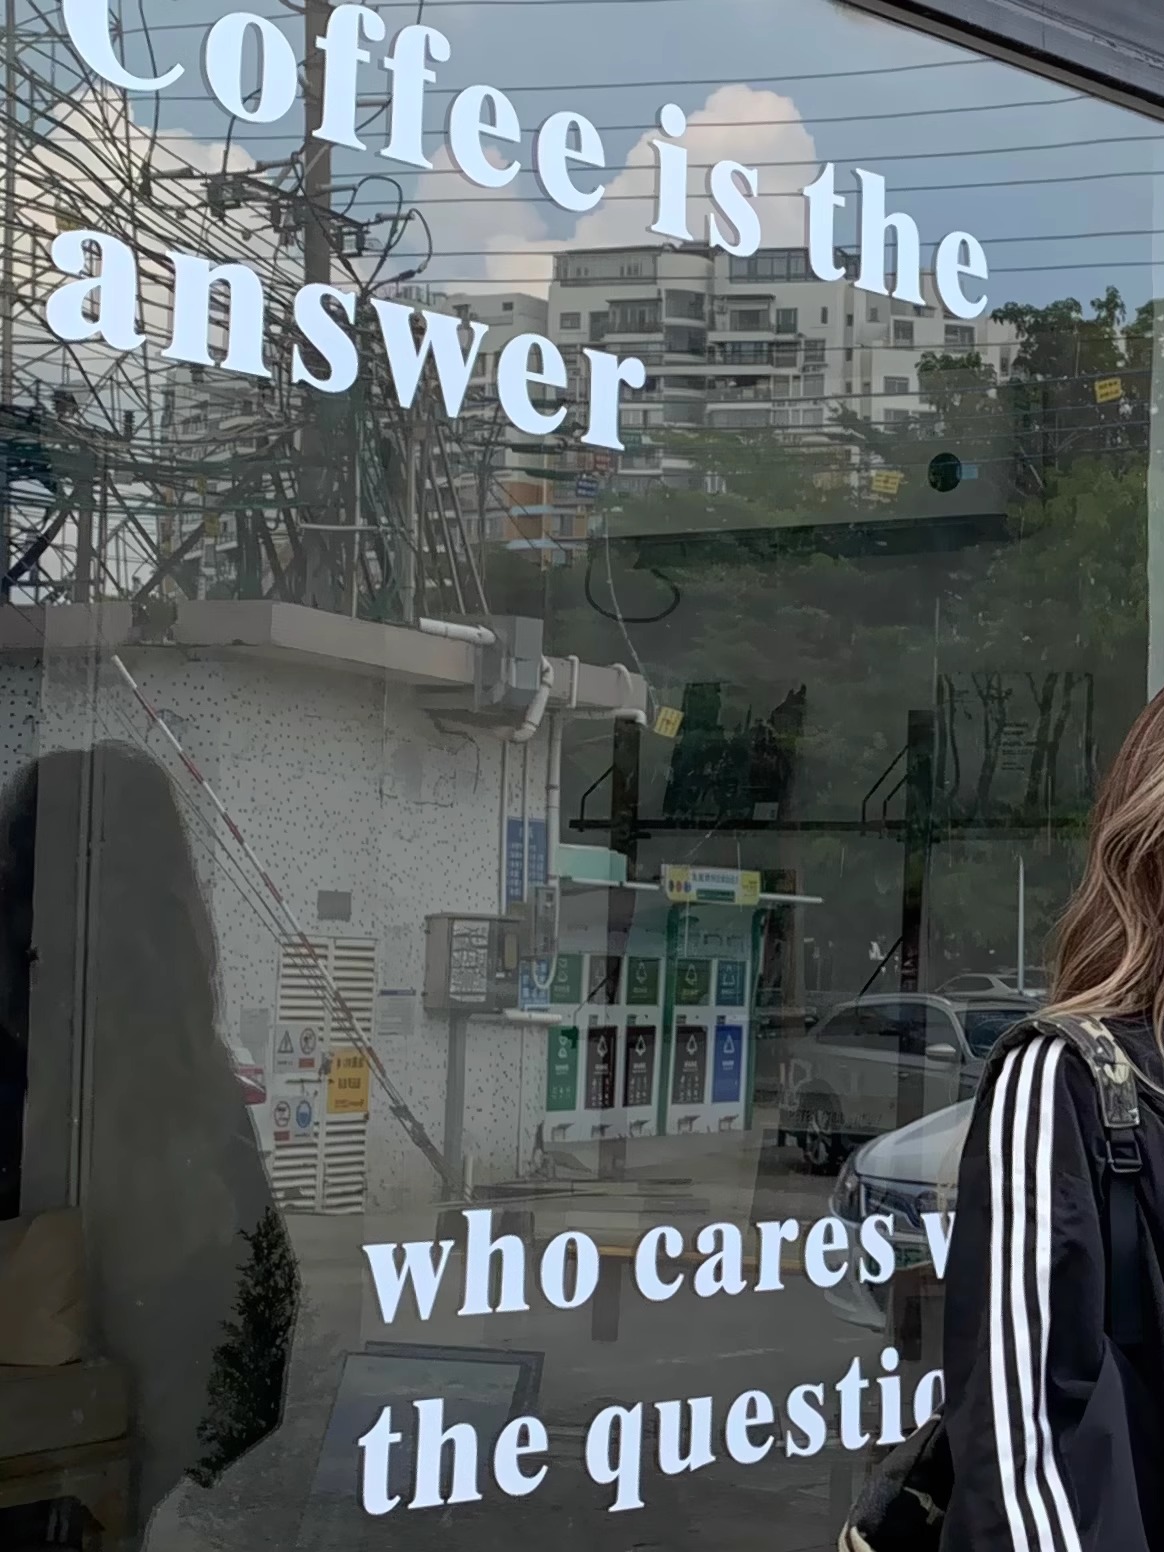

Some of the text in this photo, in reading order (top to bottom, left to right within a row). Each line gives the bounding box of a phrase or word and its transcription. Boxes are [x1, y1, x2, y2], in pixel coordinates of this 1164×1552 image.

[63, 0, 990, 320] Coffee is the
[45, 229, 647, 451] answer
[362, 1209, 600, 1324] who
[636, 1213, 896, 1301] cares
[358, 1346, 946, 1516] the questio
